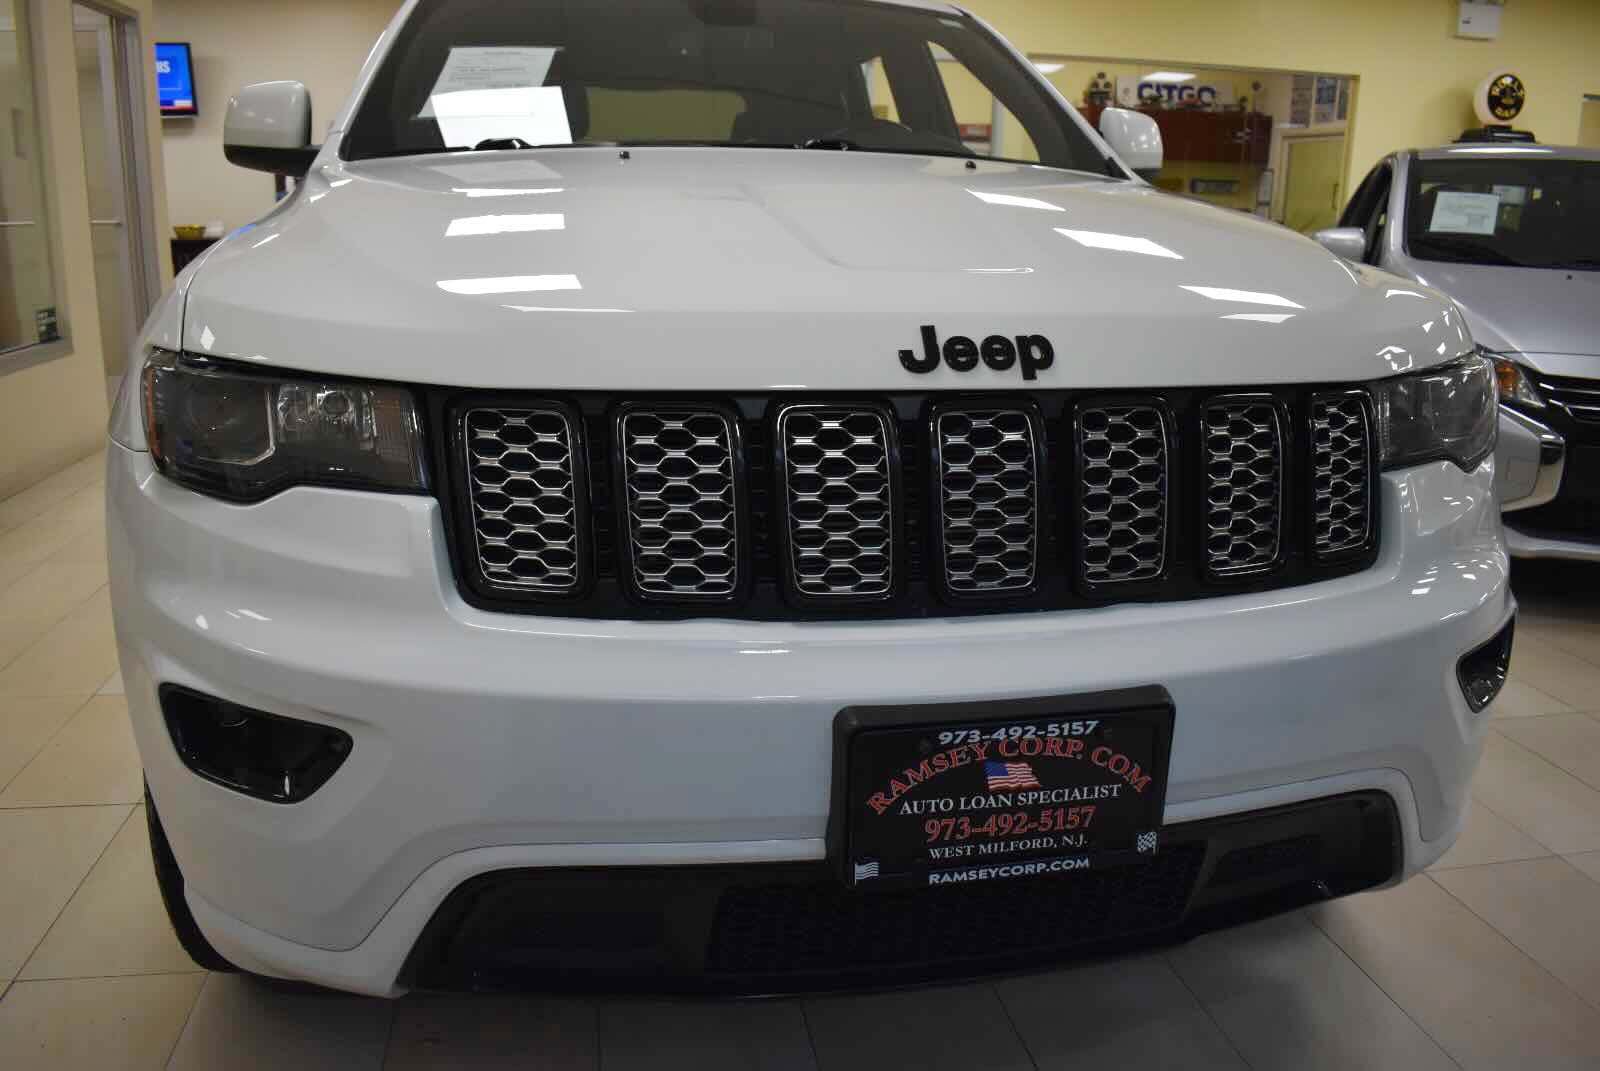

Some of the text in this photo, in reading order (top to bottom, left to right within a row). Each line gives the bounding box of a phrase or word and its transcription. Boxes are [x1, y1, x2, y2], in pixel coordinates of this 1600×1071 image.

[898, 325, 1055, 380] Jeep
[938, 720, 1099, 745] 973-492-5157
[866, 736, 1152, 816] RAMSEY CORP. COM
[899, 784, 1122, 816] AUTO LOAN SPECIALIST
[925, 805, 1097, 843] 973-492-5157
[929, 832, 1089, 860] WEST MILFORD, N.J.
[928, 857, 1090, 885] RAMSEYCORP.COM
